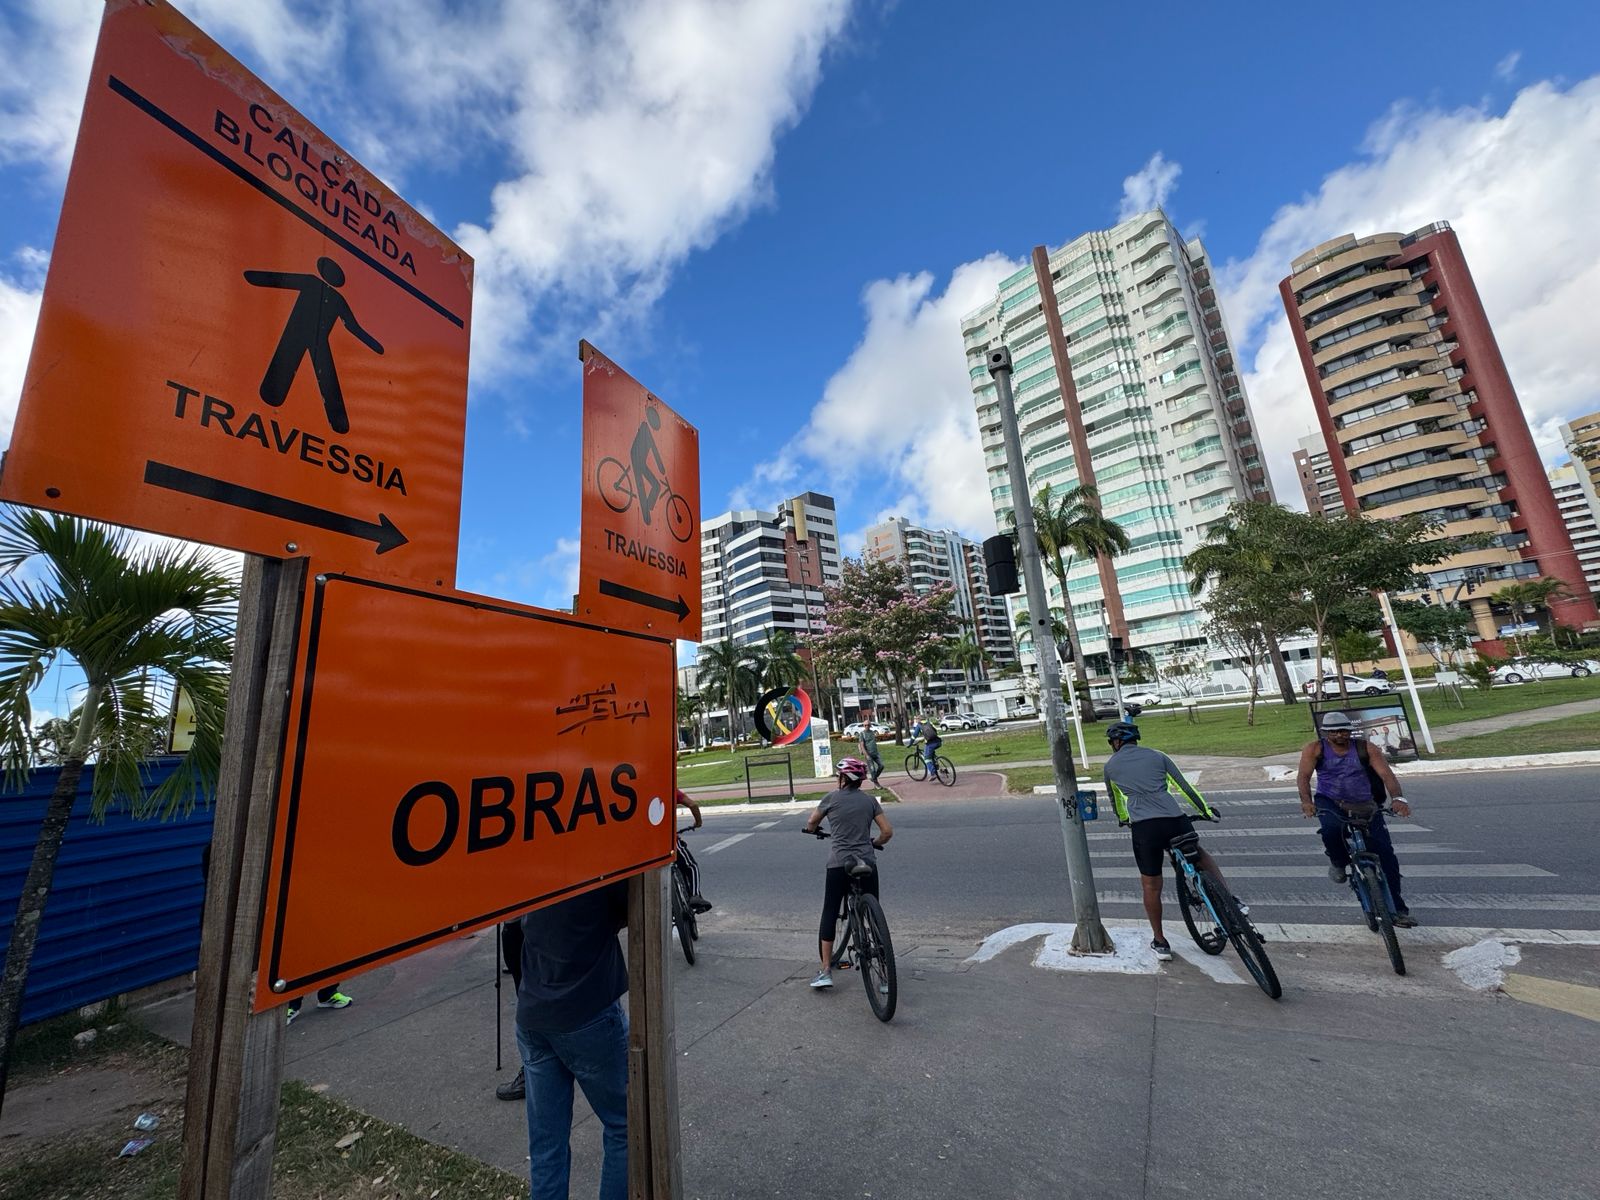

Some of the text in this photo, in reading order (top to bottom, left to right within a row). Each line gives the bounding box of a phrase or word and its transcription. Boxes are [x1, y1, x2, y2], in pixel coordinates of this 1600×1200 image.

[213, 109, 417, 275] BLOQUEADA
[249, 103, 401, 235] CALÇADA
[166, 380, 407, 496] TRAVESSIA
[603, 528, 688, 579] TRAVESSIA
[391, 763, 638, 867] OBRAS
